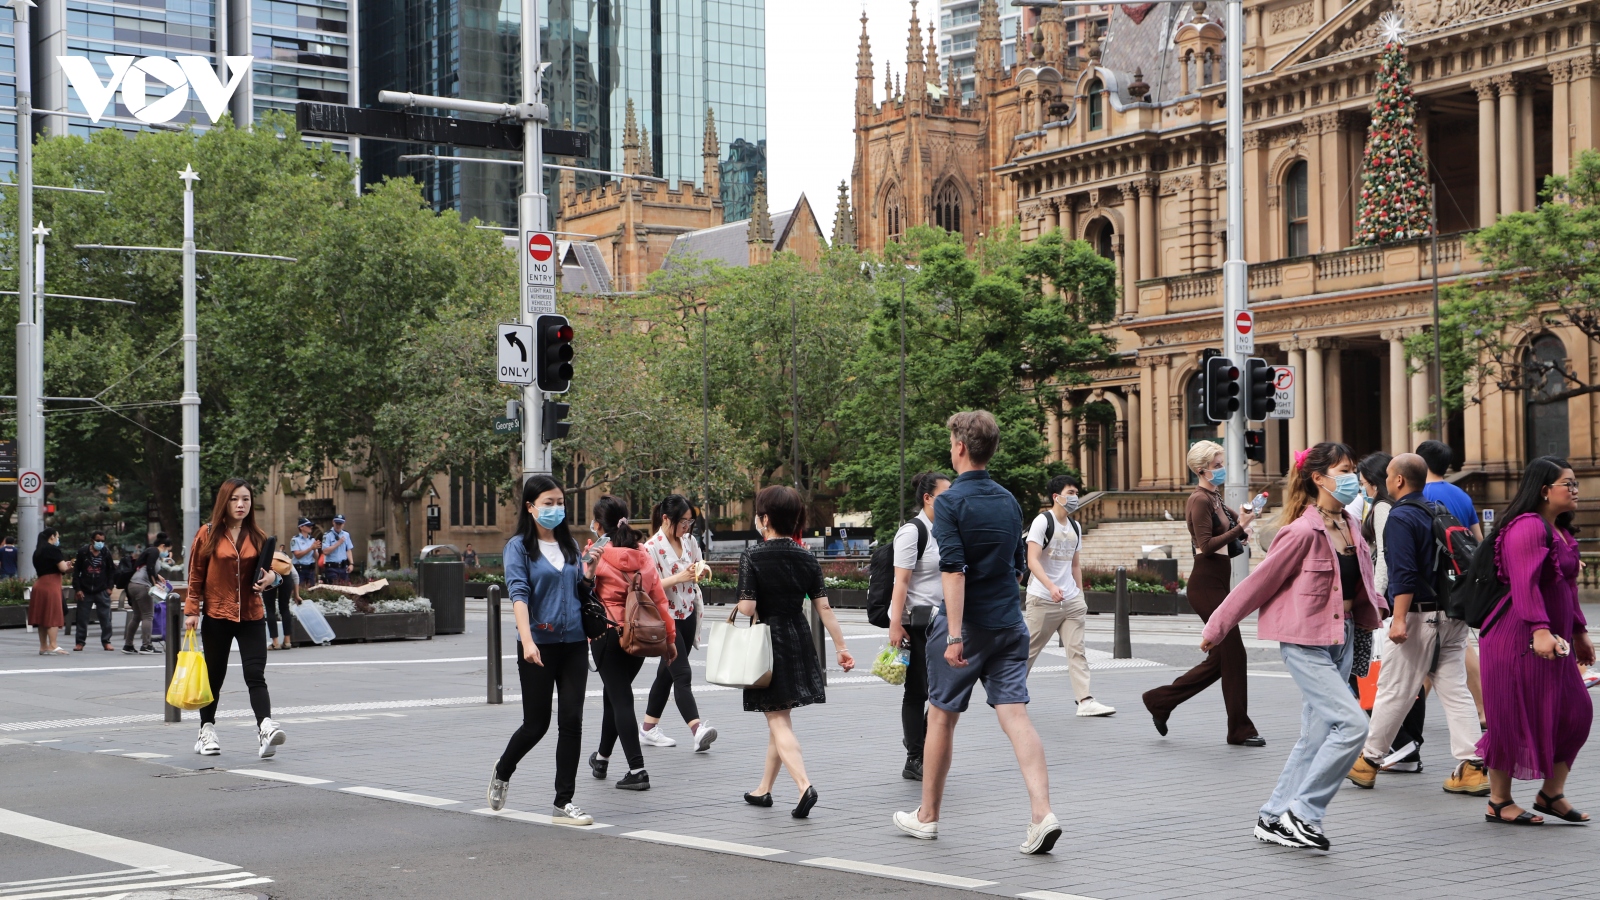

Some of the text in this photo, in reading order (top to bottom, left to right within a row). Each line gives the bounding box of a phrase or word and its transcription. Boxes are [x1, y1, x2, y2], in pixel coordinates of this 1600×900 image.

[534, 263, 548, 273] NO
[529, 273, 552, 282] ENTRY
[1239, 336, 1249, 344] NO
[501, 366, 529, 378] ONLY
[1275, 391, 1289, 400] NO
[495, 421, 514, 431] George
[24, 477, 37, 488] 20
